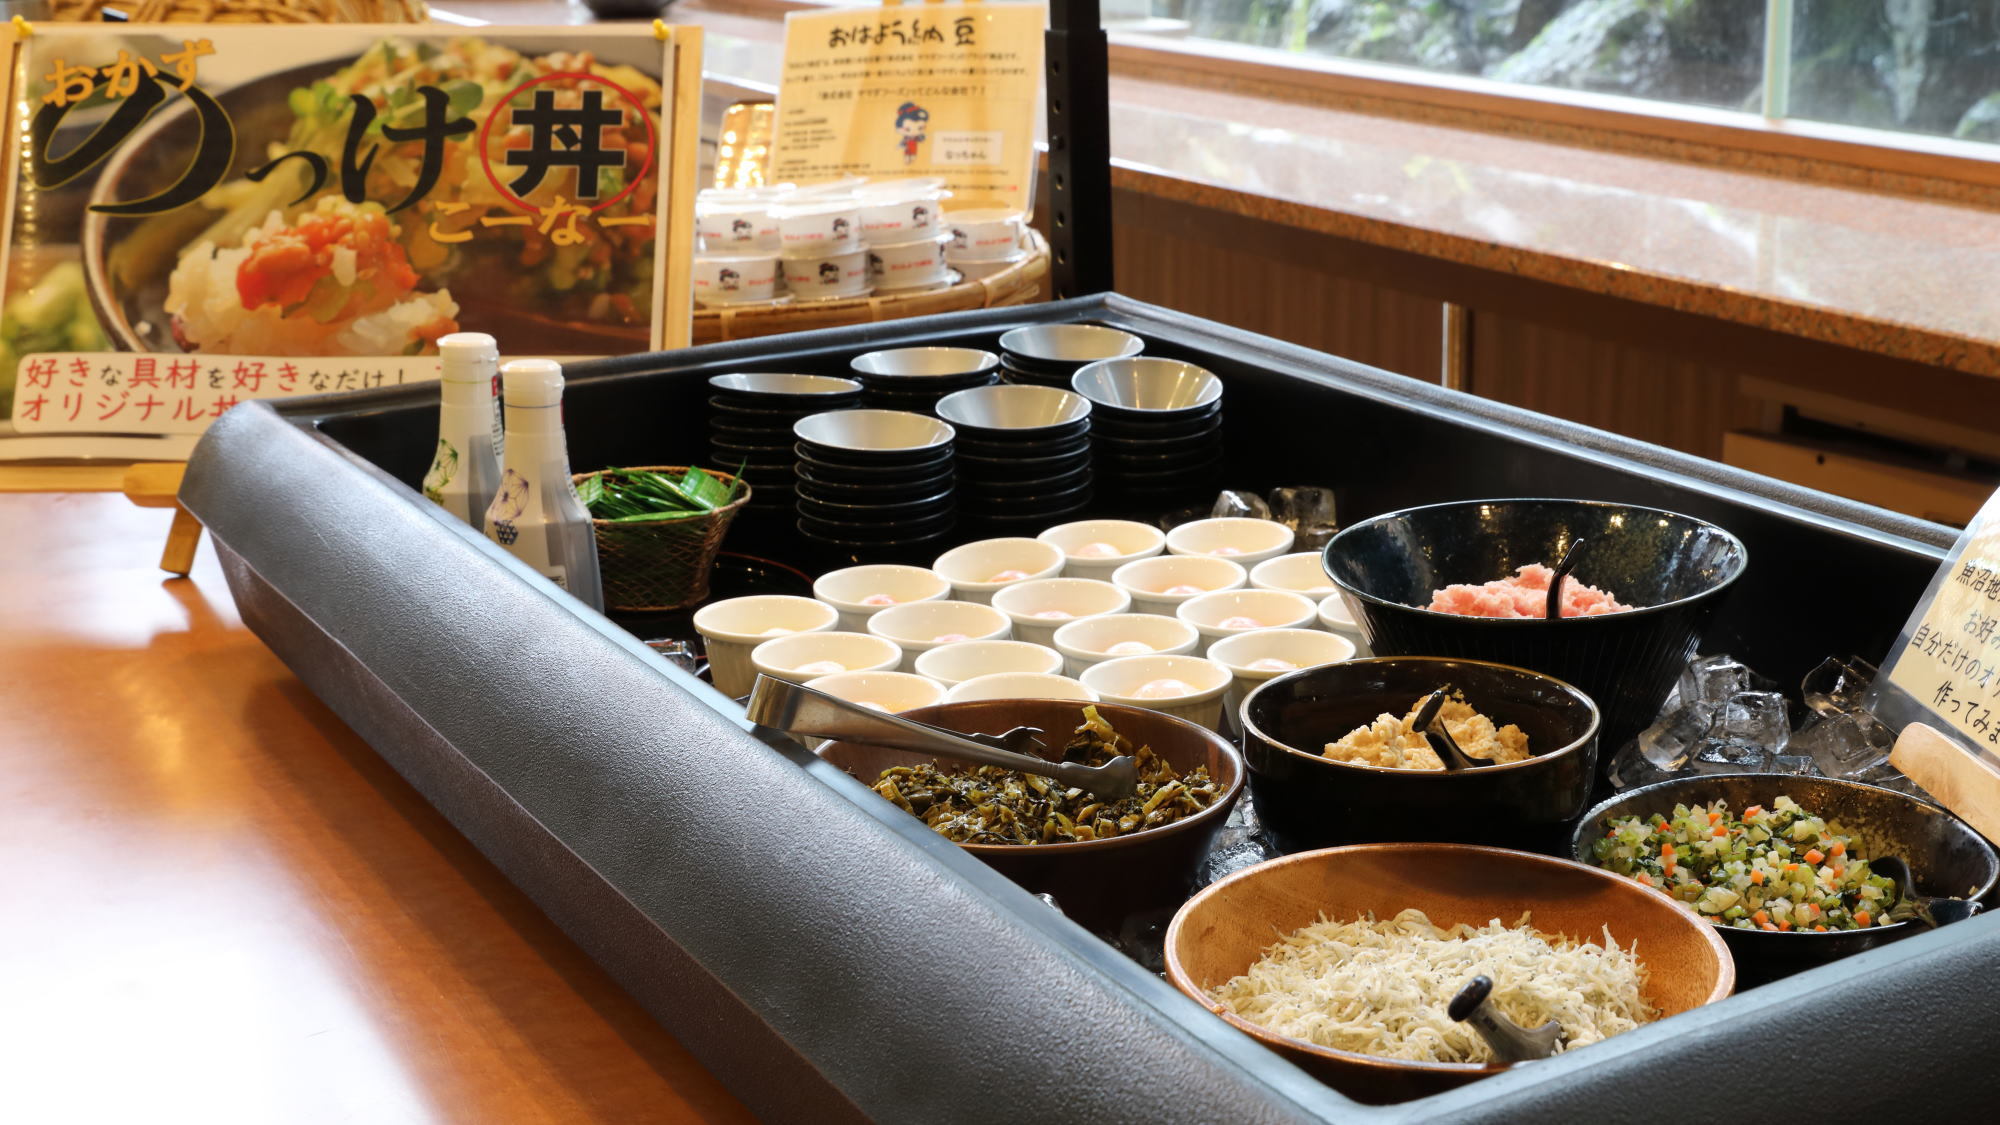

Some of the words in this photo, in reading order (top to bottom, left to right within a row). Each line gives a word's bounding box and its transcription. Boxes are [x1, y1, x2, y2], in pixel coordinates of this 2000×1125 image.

[829, 17, 976, 49] おはよう納豆
[42, 39, 216, 107] おかず
[30, 66, 625, 217] のっけ丼
[428, 196, 651, 246] こーなー
[1956, 562, 2000, 603] 魚沼地
